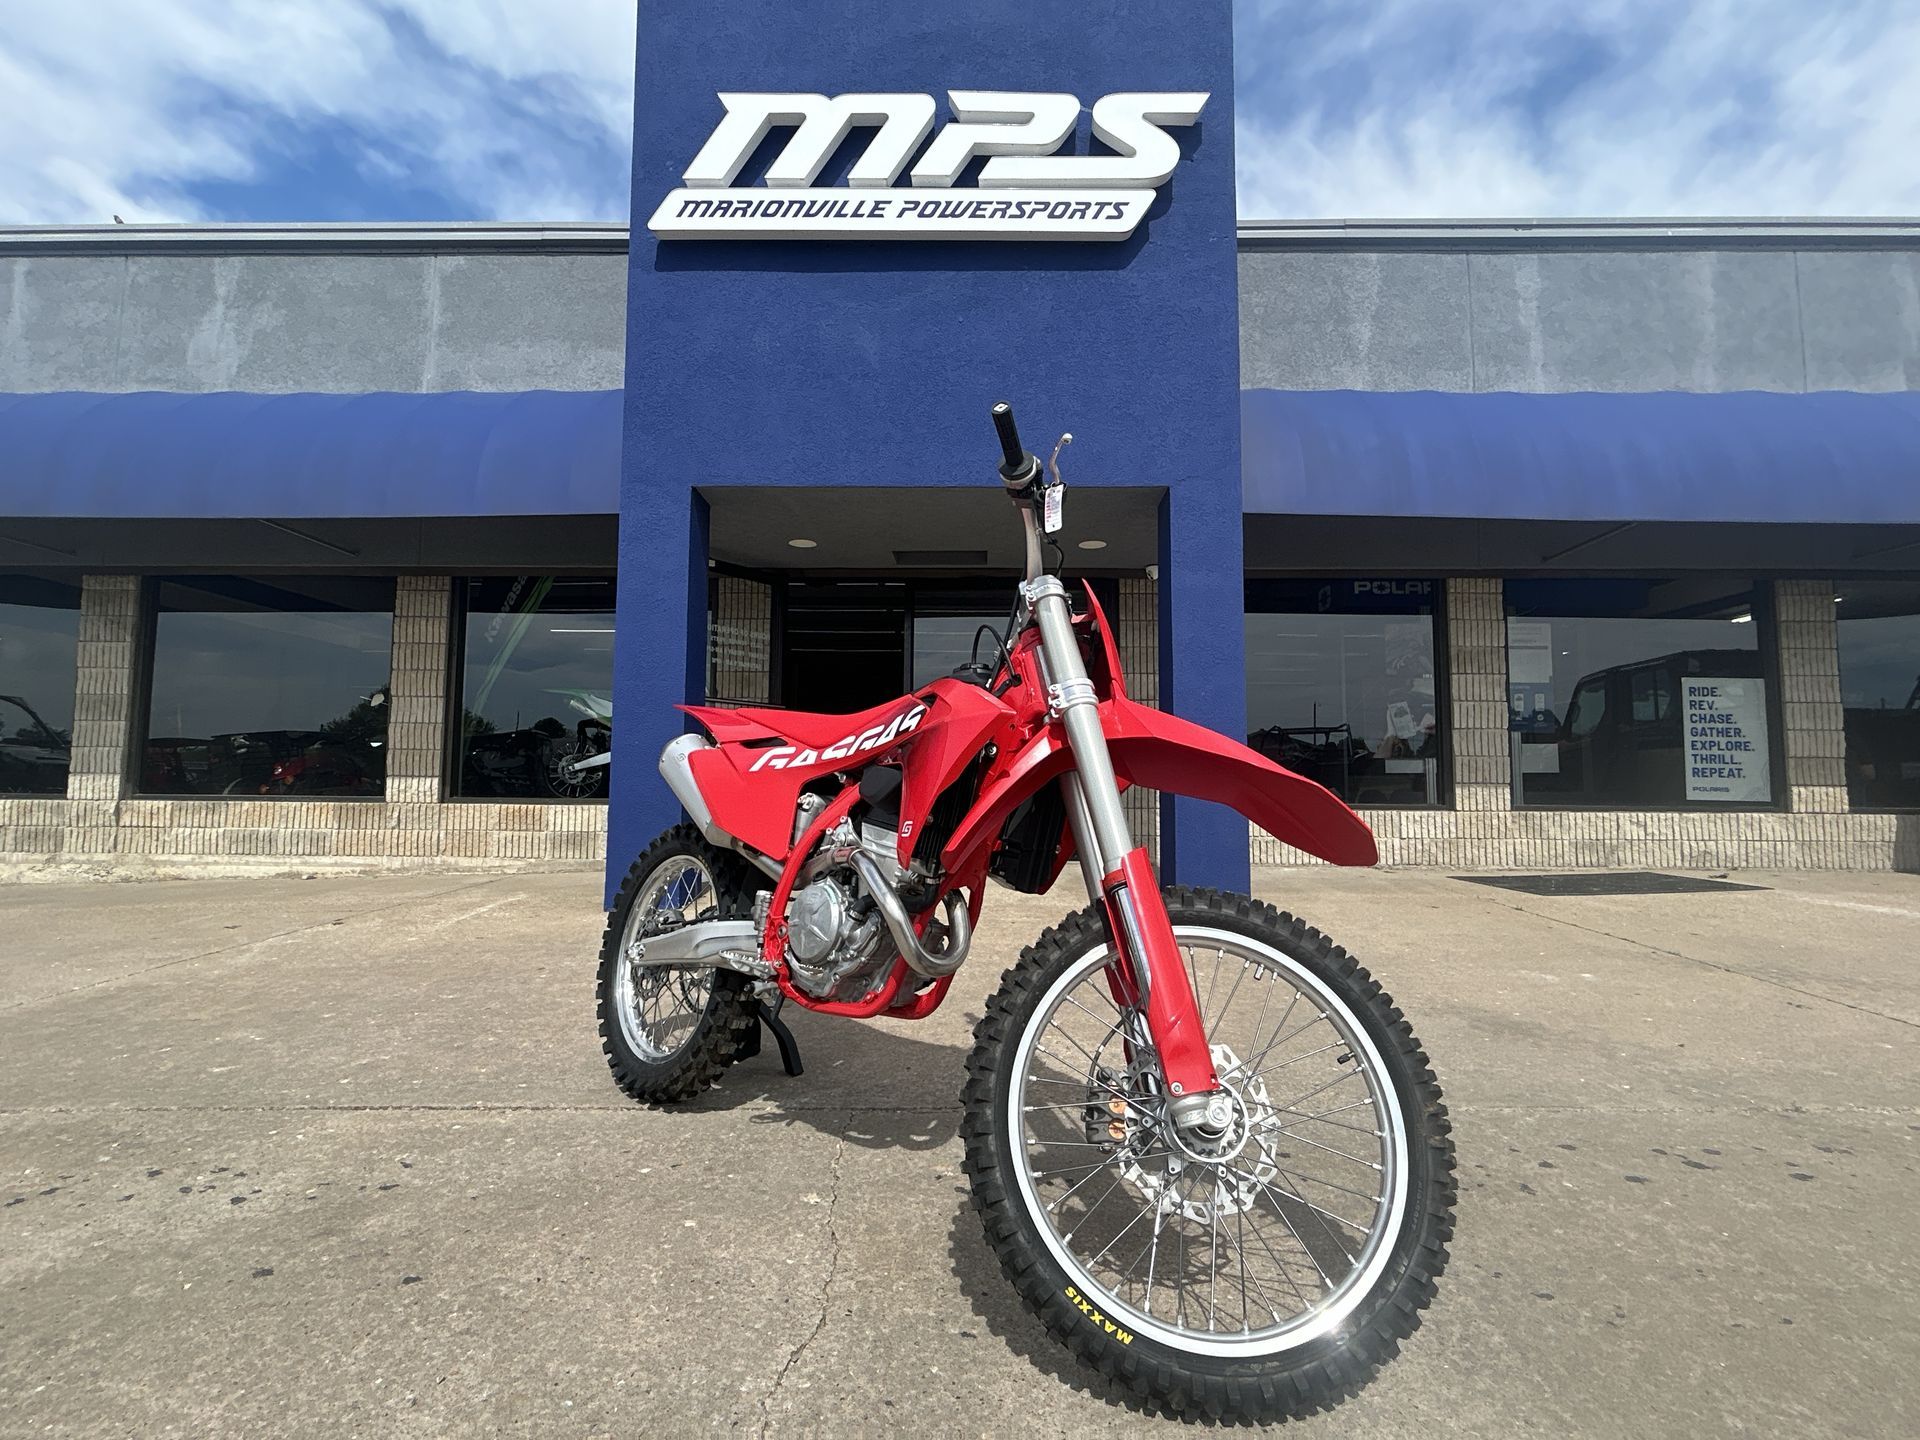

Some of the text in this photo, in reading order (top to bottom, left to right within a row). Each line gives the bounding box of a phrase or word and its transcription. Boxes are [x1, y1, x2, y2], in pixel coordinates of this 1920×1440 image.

[682, 90, 1211, 187] MPS
[676, 199, 1130, 221] MARIONVILLE POWERSPORTS
[1688, 686, 1722, 698] RIDE.
[1689, 699, 1718, 711] REV.
[1690, 713, 1737, 724] CHASE.
[749, 704, 926, 772] GASGAS
[1690, 726, 1746, 738] GATHER.
[1691, 740, 1755, 752] EXPLORE.
[1691, 753, 1742, 765] THRILL.
[1692, 767, 1746, 779] REPEAT.
[1065, 1286, 1134, 1345] MAXXIS
